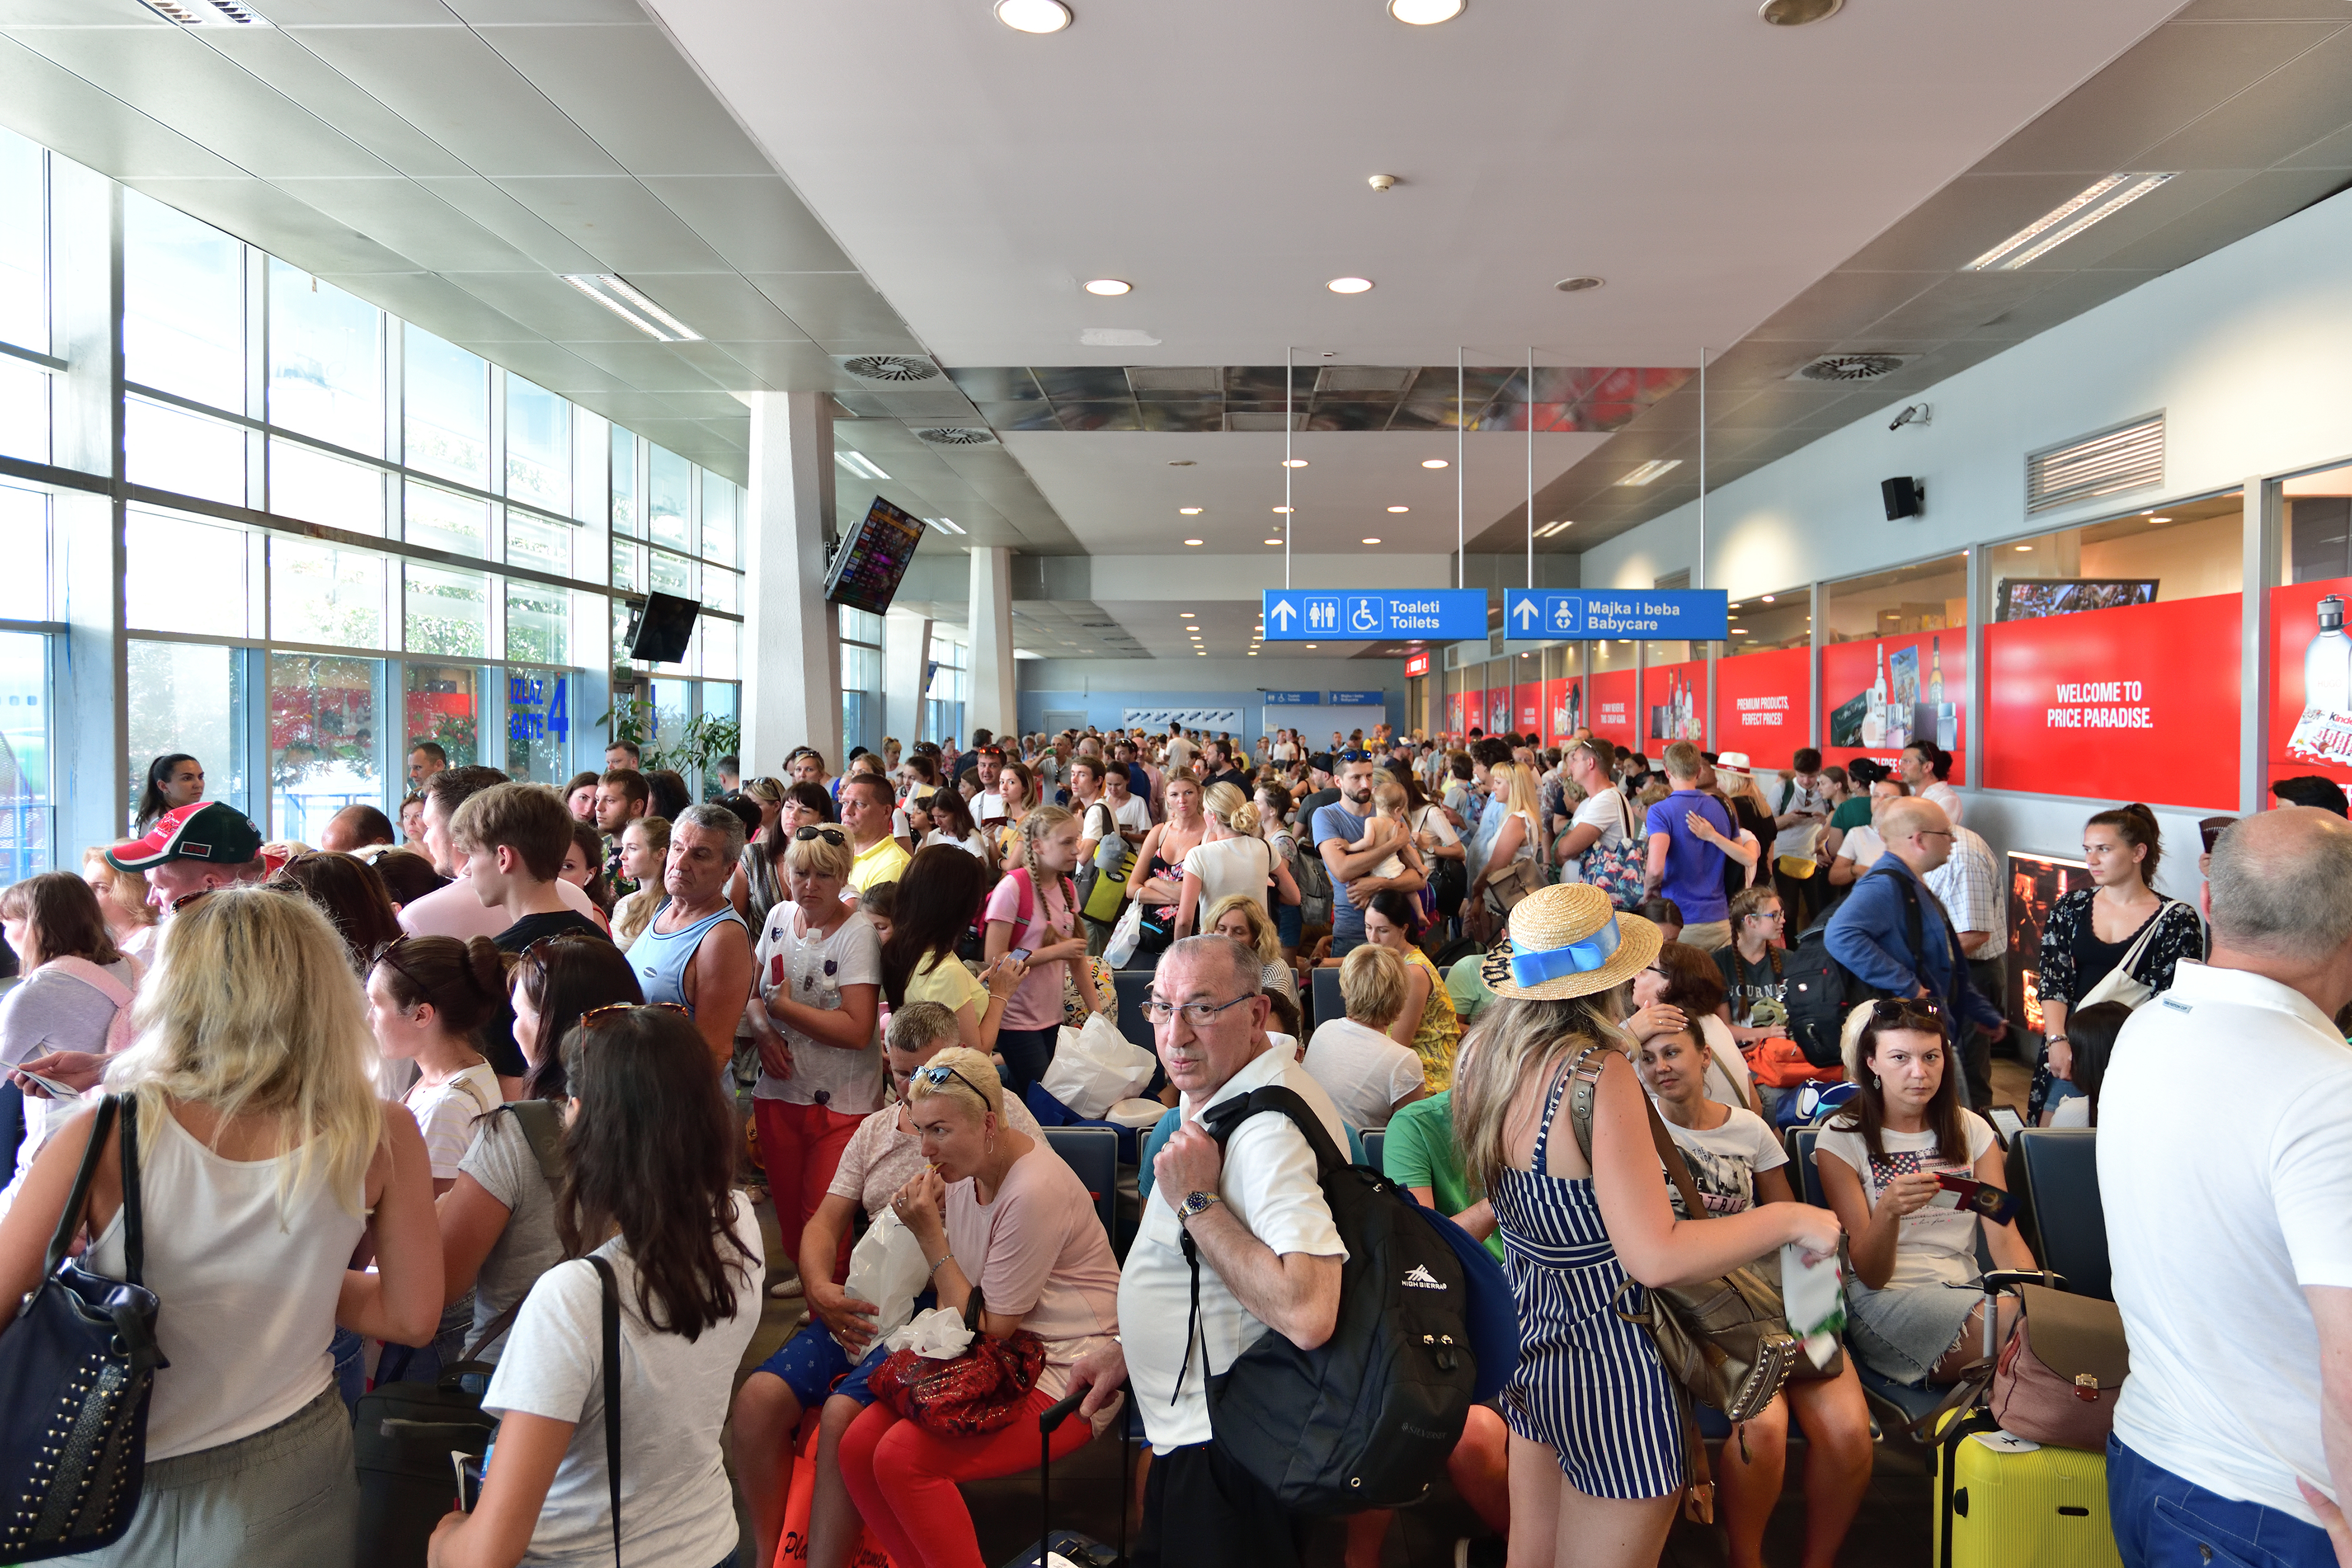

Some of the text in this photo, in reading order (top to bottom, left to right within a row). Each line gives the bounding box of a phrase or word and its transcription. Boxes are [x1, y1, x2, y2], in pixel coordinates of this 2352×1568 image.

[1390, 600, 1439, 613] Toaleti
[1589, 601, 1680, 617] Majka i beba
[1390, 616, 1440, 628] Toilets
[1588, 616, 1658, 633] Babycare
[510, 678, 543, 704] IZLAZ
[2056, 680, 2141, 703] WELCOME TO
[2318, 679, 2341, 688] HUGO
[547, 678, 569, 743] 4
[1737, 696, 1789, 710] PREMIUM PRODUCTS,
[1742, 712, 1783, 726] PERFECT PRICES!
[2047, 707, 2153, 728] PRICE PARADISE.
[511, 713, 543, 740] GATE
[1692, 1146, 1705, 1156] THE
[1700, 1195, 1746, 1213] TALE
[783, 1532, 808, 1562] Pla
